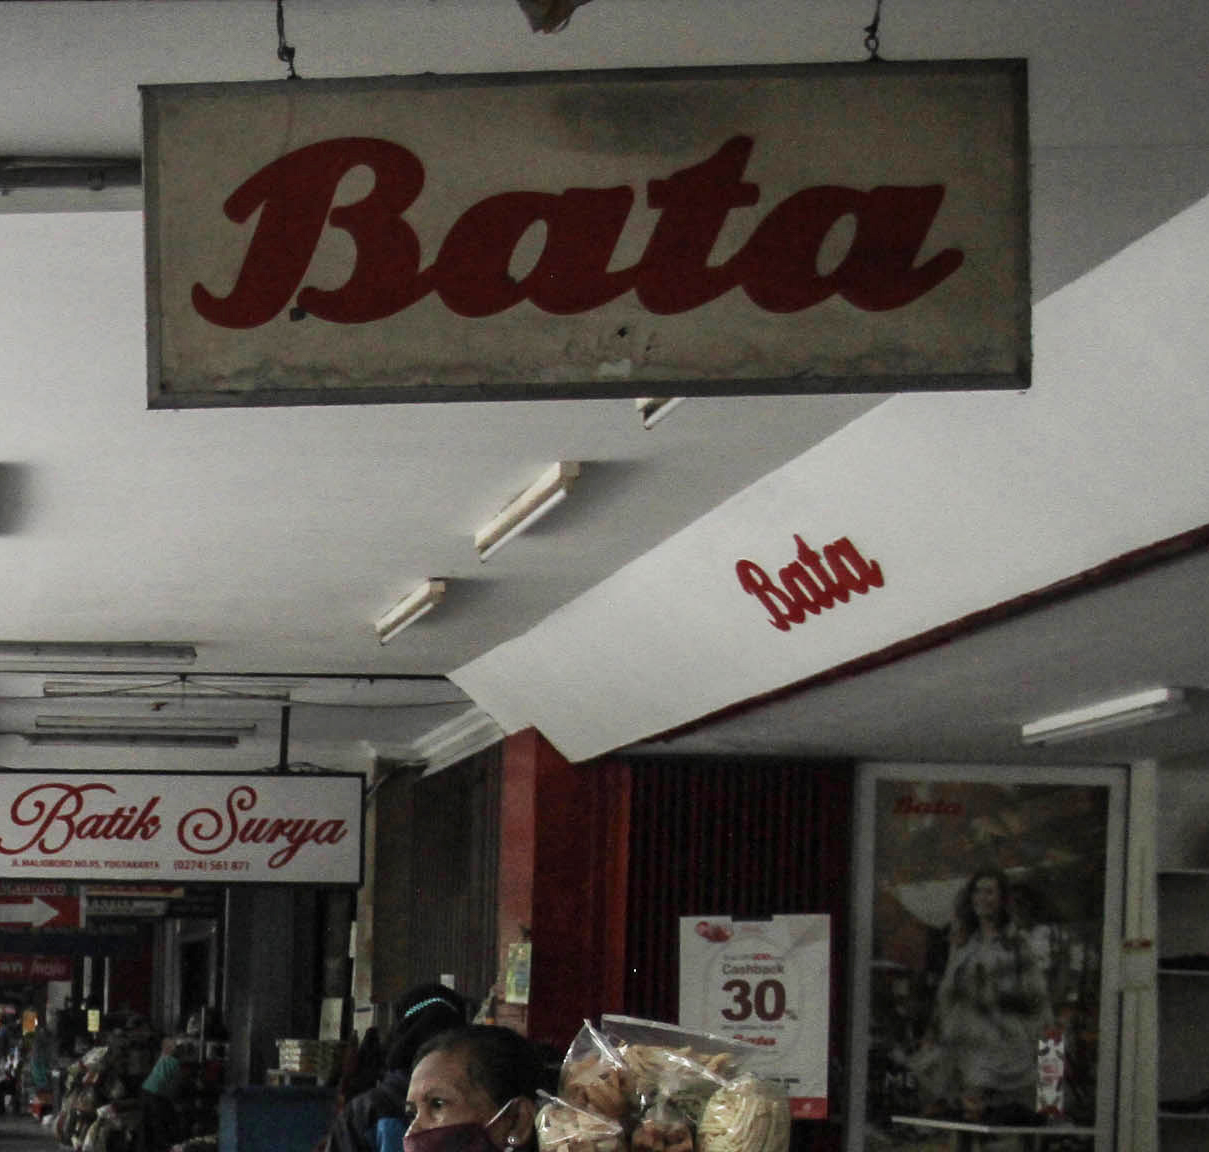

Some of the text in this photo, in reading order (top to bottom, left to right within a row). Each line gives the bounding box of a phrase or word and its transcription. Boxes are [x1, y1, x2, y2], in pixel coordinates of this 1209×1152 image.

[191, 135, 965, 329] Bata
[736, 534, 885, 632] Bata
[176, 785, 348, 868] Surya
[209, 861, 228, 871] 561
[721, 962, 785, 975] Cashback
[720, 979, 787, 1022] 30
